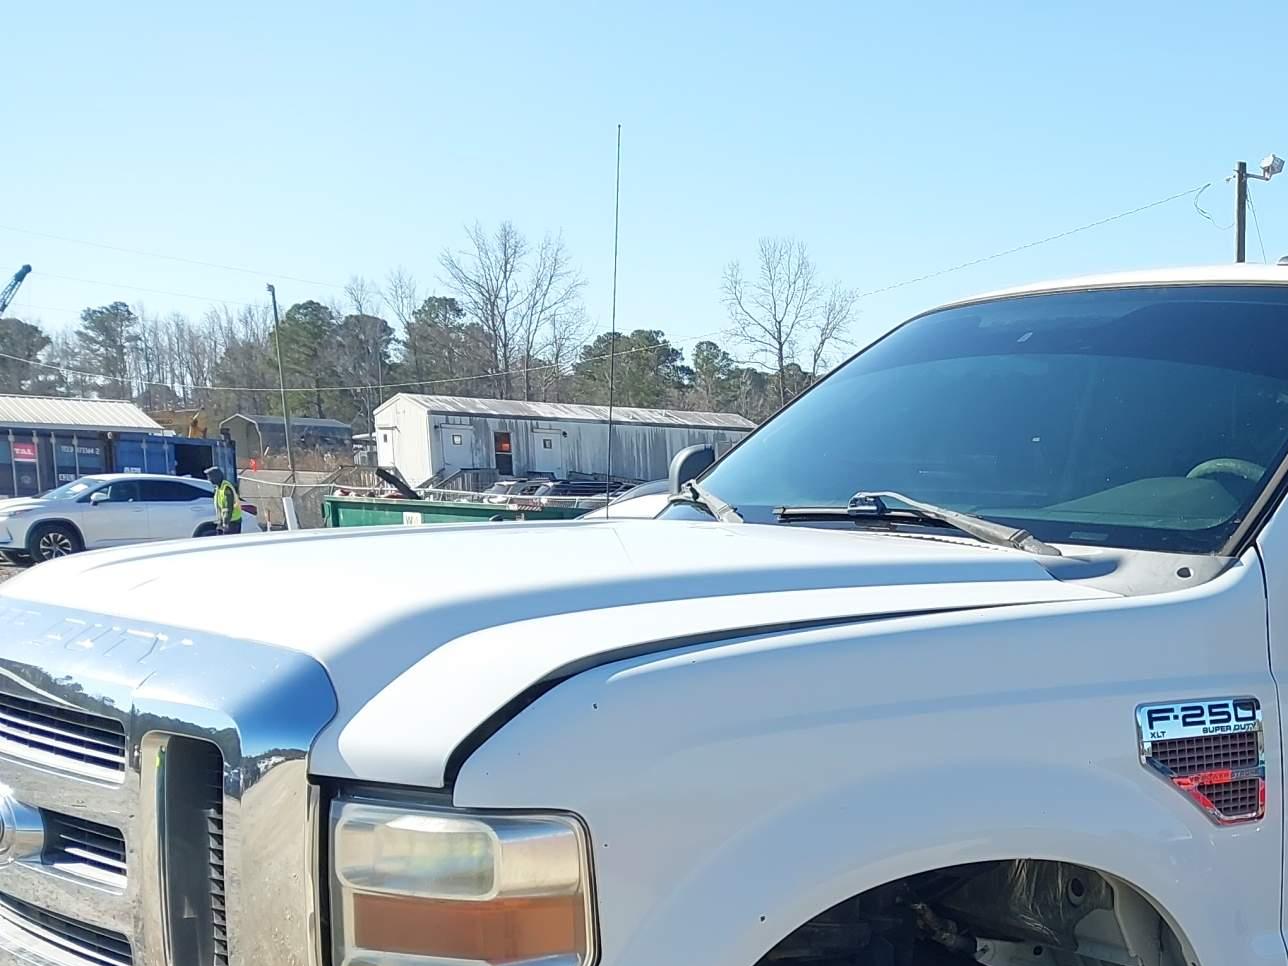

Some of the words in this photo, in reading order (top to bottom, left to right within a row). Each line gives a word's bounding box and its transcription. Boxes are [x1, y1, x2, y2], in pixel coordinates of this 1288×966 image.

[1147, 701, 1259, 730] F-250
[1150, 731, 1167, 739] XLT
[1202, 725, 1232, 735] SUPER
[1233, 722, 1257, 732] DUTY
